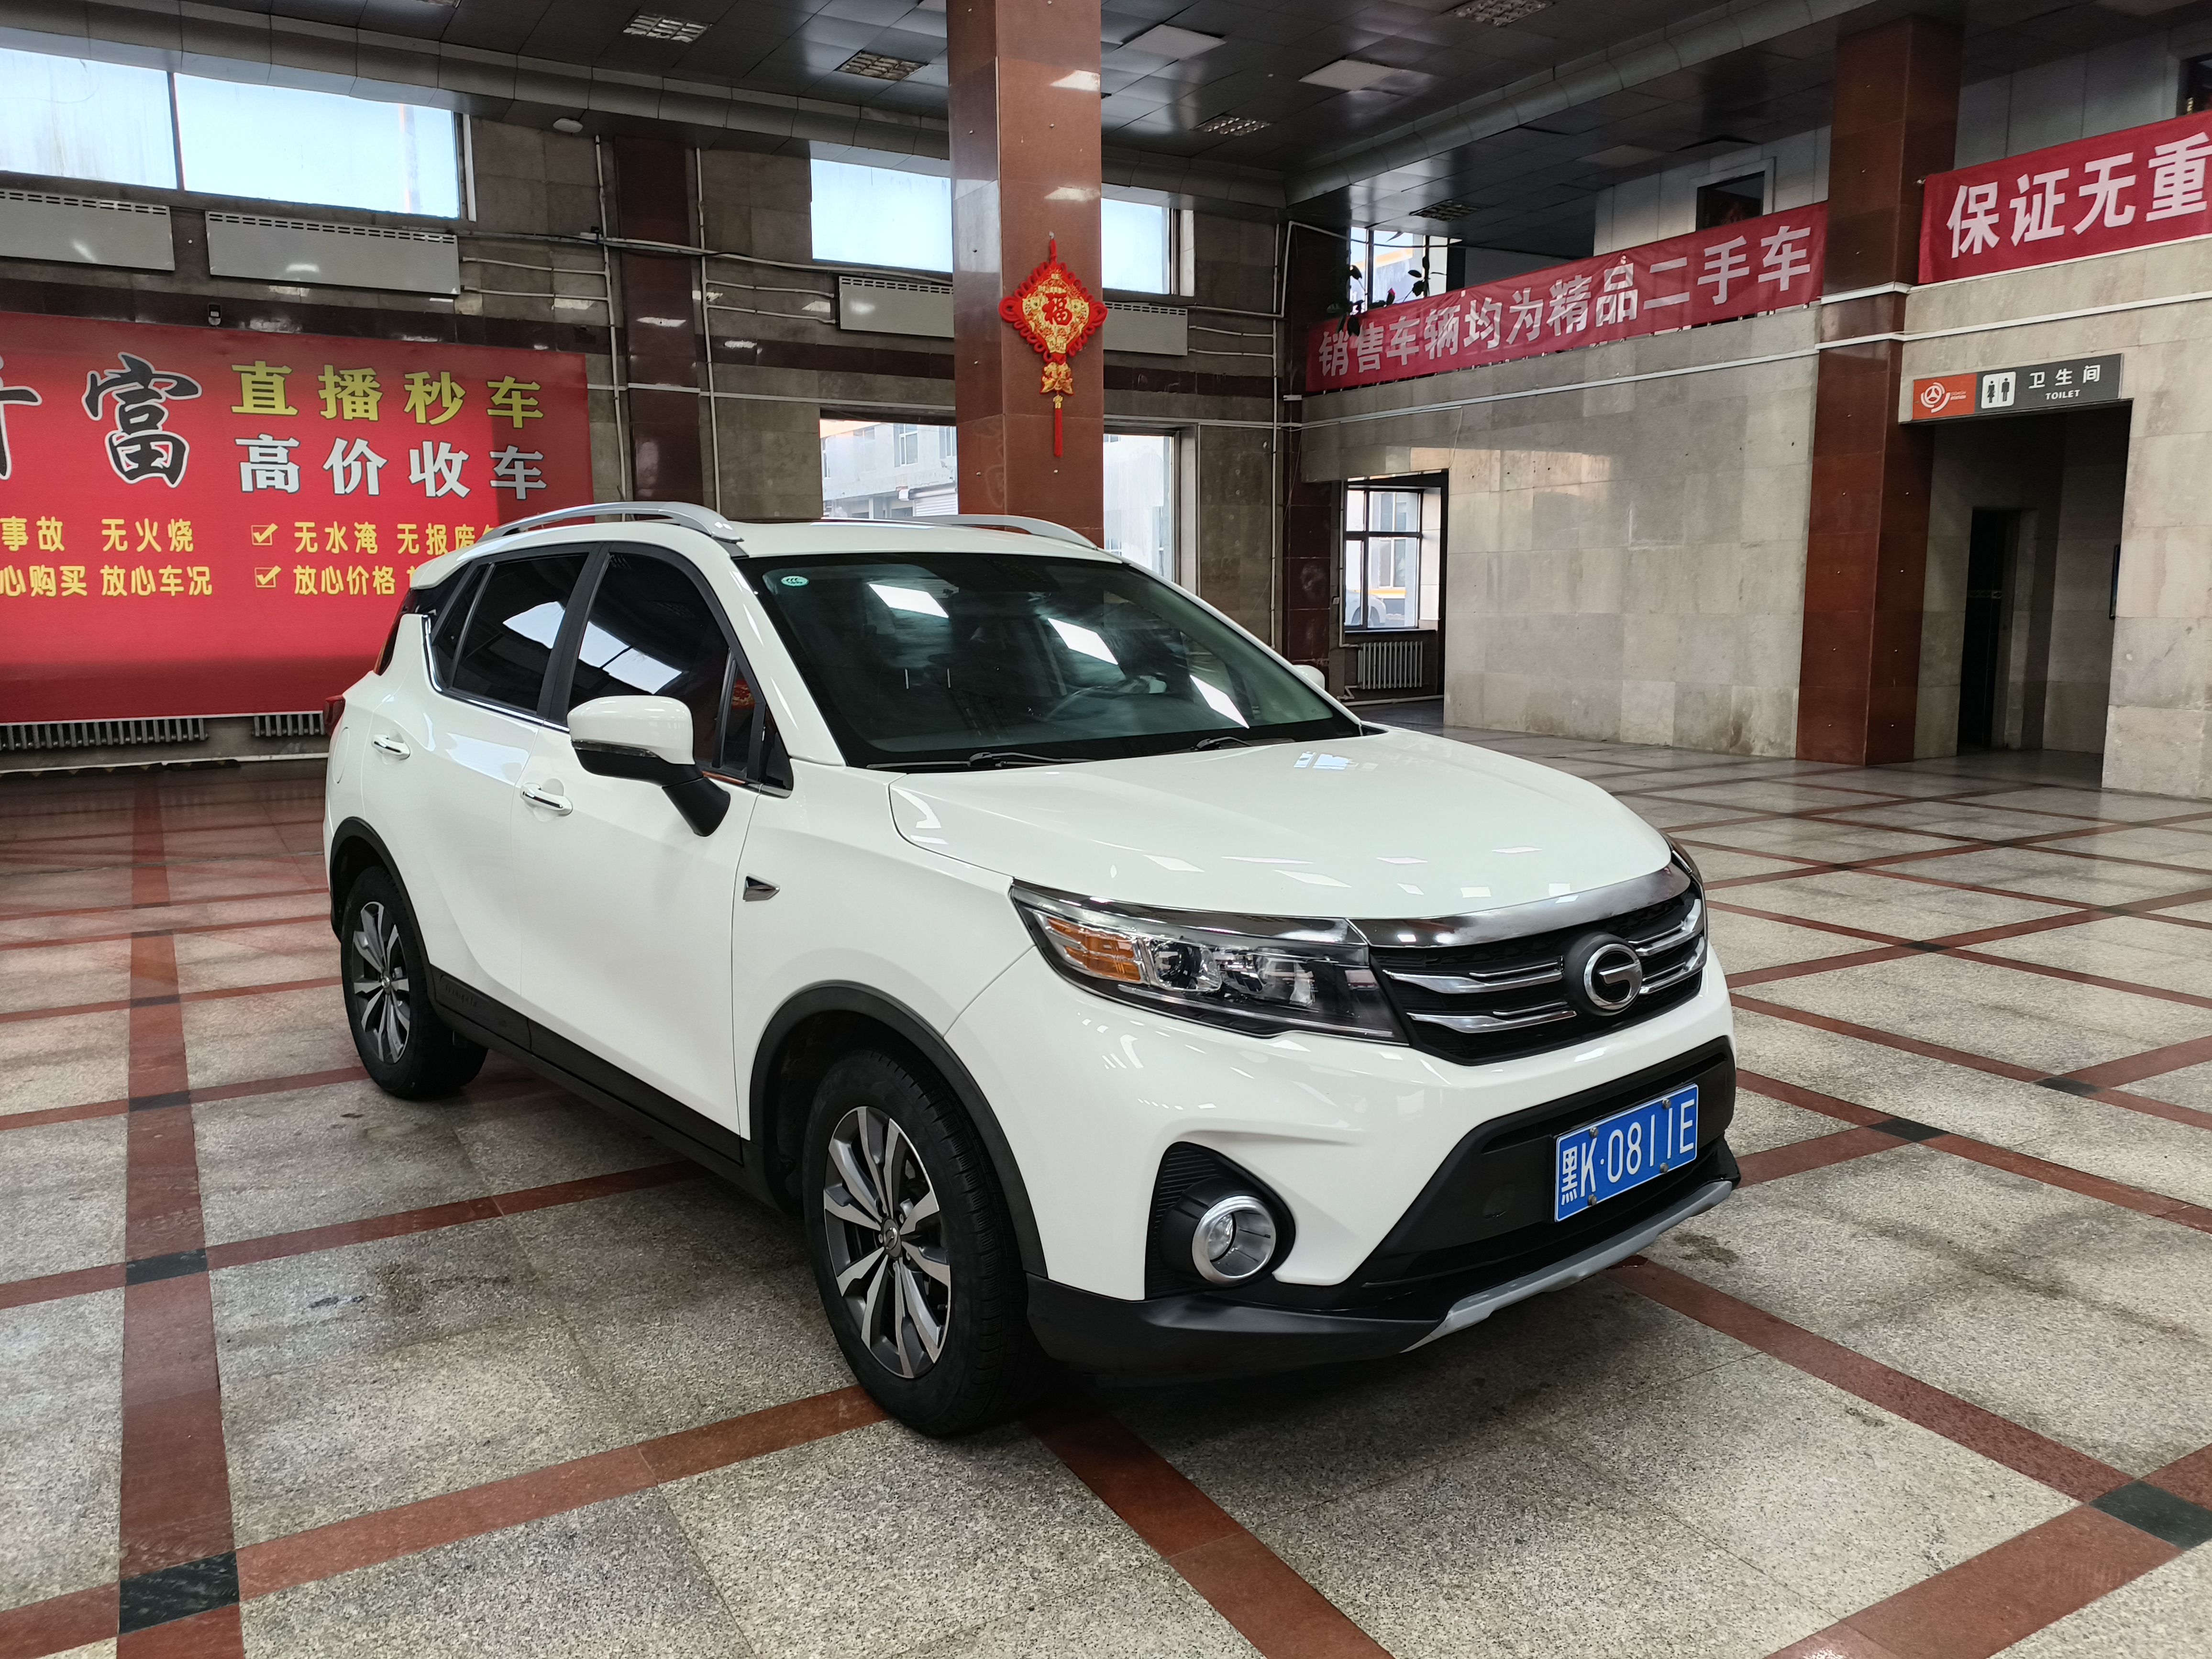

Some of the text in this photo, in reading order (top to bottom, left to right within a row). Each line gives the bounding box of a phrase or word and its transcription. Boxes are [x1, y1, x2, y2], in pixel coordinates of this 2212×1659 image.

[1947, 131, 2212, 259] 保证无重
[1041, 292, 1073, 326] 福
[1318, 225, 1811, 377] 销售车辆均为精品二手车
[2028, 364, 2101, 389] 卫生间
[231, 360, 544, 429] 直播秒车
[2045, 389, 2081, 400] TOILET
[235, 433, 547, 500] 高价收车
[101, 518, 194, 552] 无火烧
[294, 521, 496, 555] 无水淹 无报废
[100, 564, 212, 597] 放心车况
[293, 564, 395, 595] 放心价格
